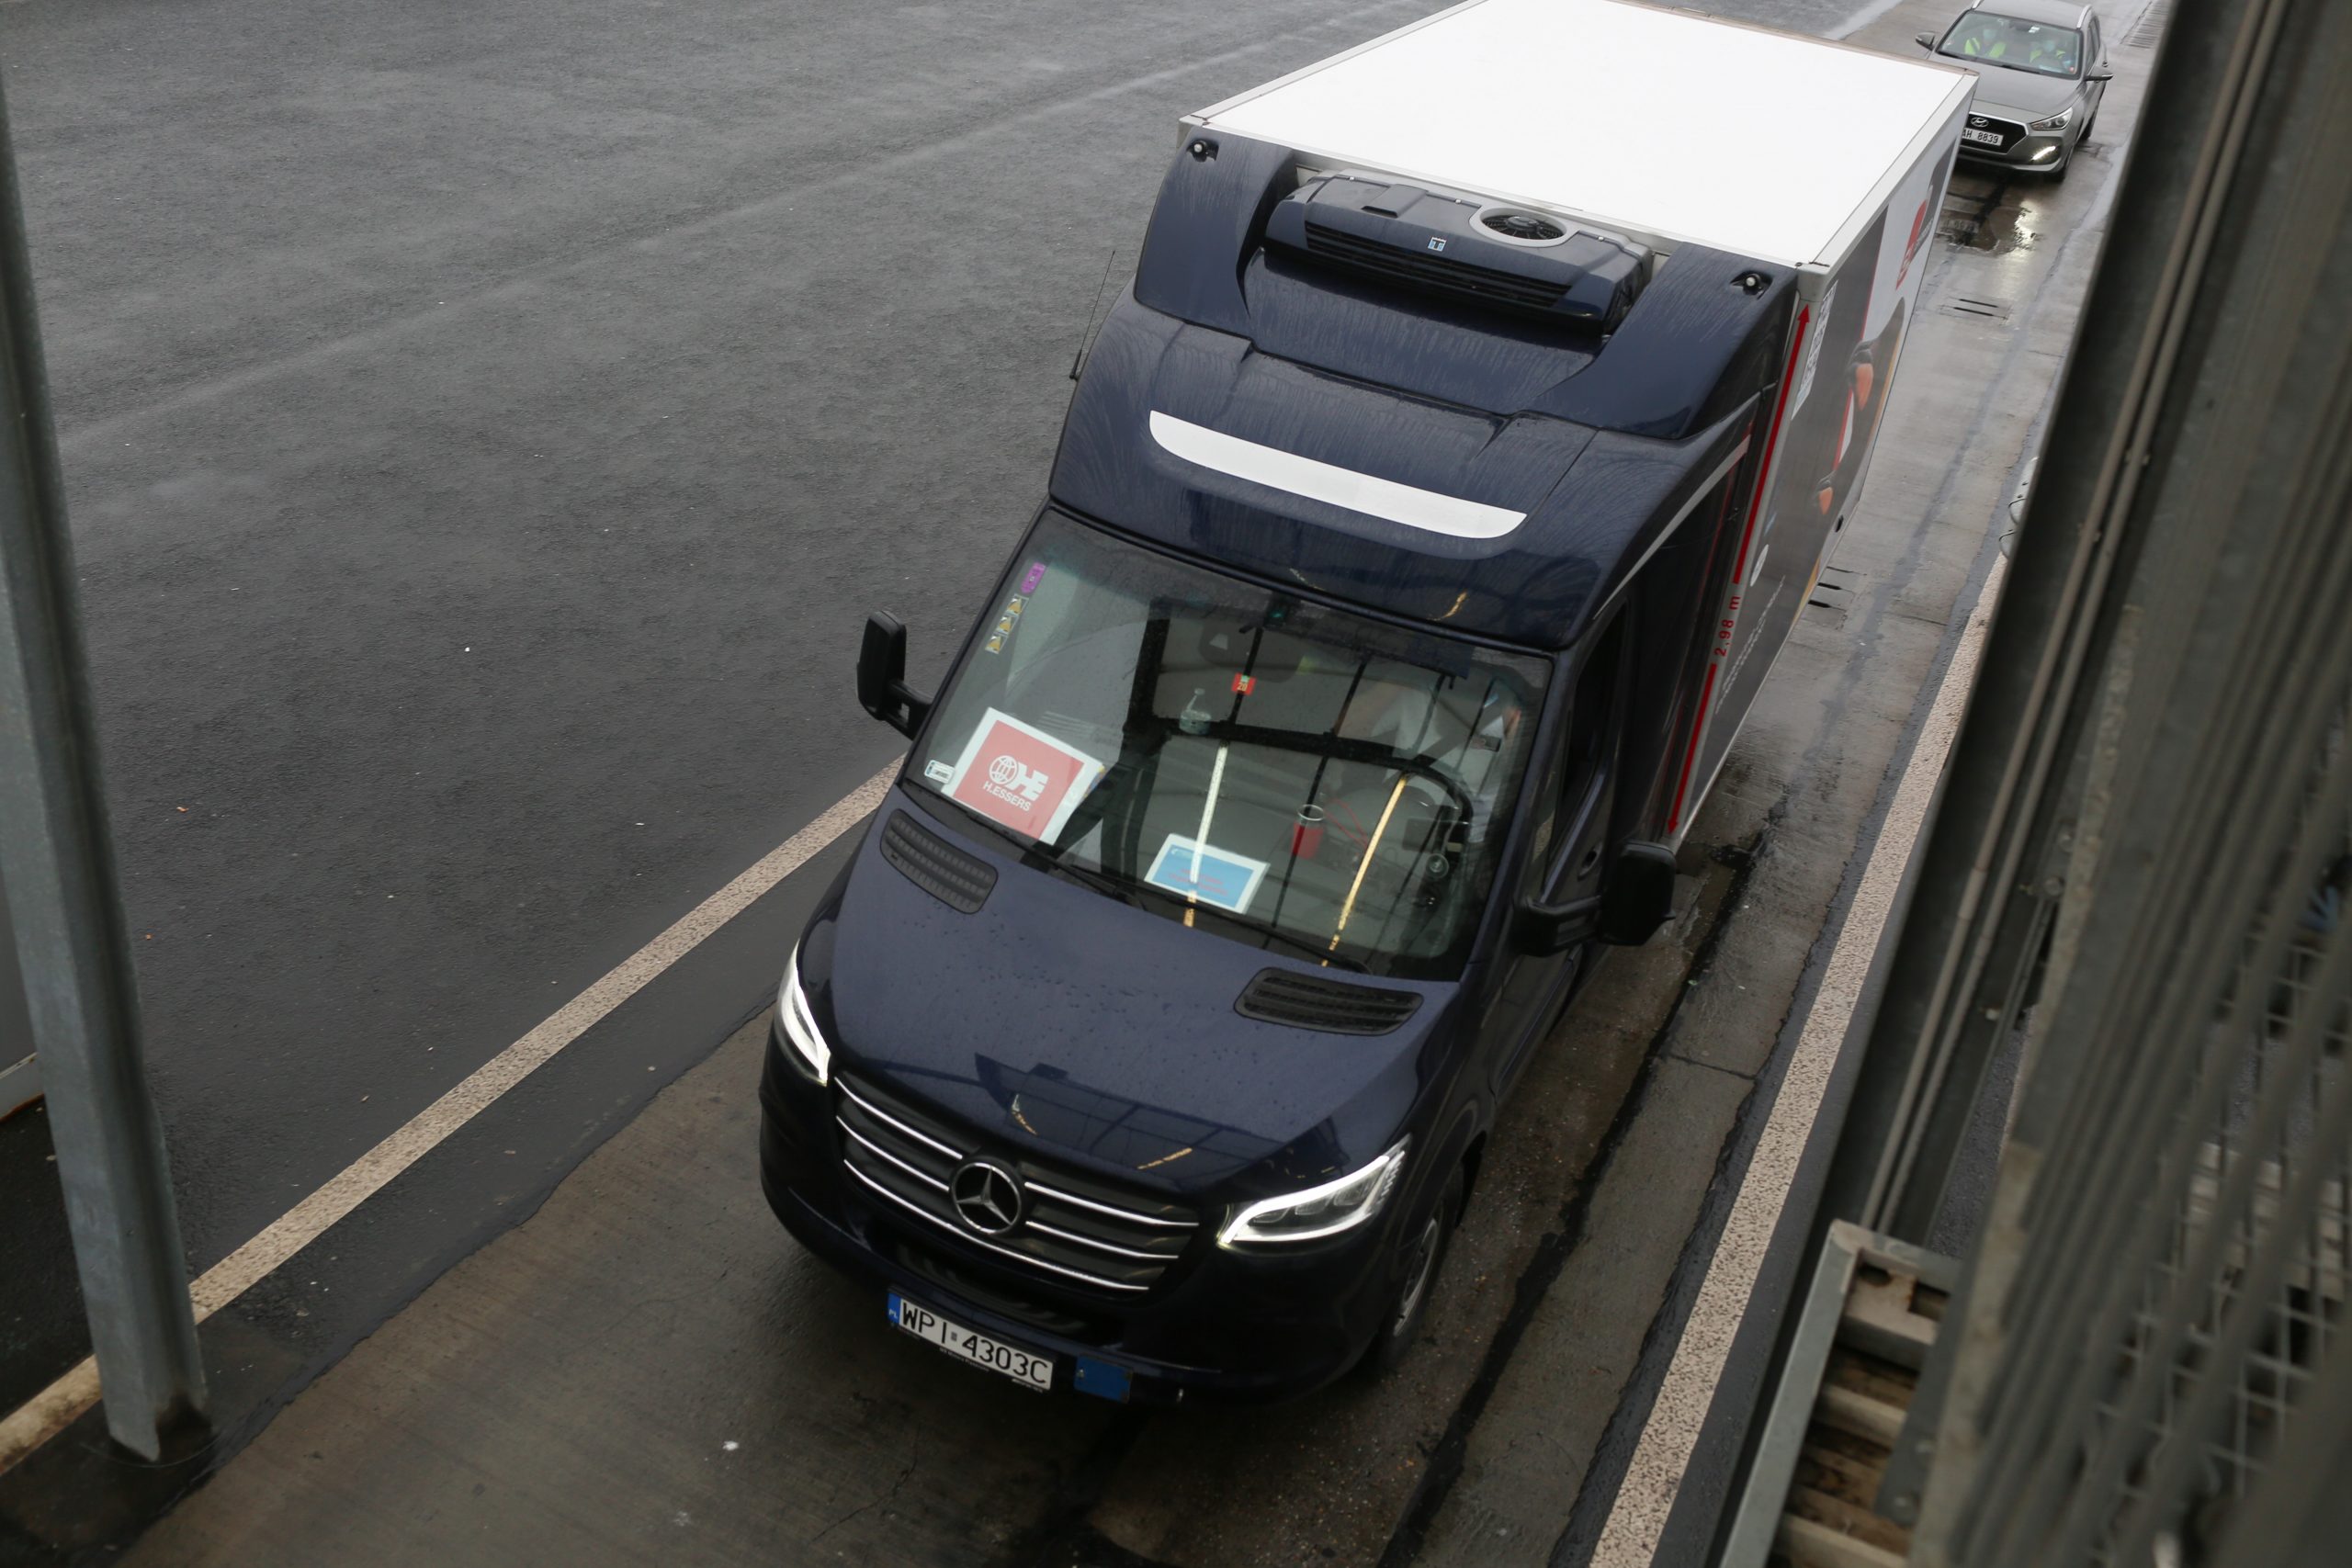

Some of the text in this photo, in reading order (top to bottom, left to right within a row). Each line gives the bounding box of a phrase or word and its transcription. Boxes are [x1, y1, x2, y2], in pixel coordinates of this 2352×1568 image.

[1977, 131, 1998, 143] 8839
[1729, 596, 1741, 610] m
[983, 781, 1031, 811] H.ESSERS
[903, 1302, 947, 1344] WPI
[962, 1334, 1048, 1384] 4303C
